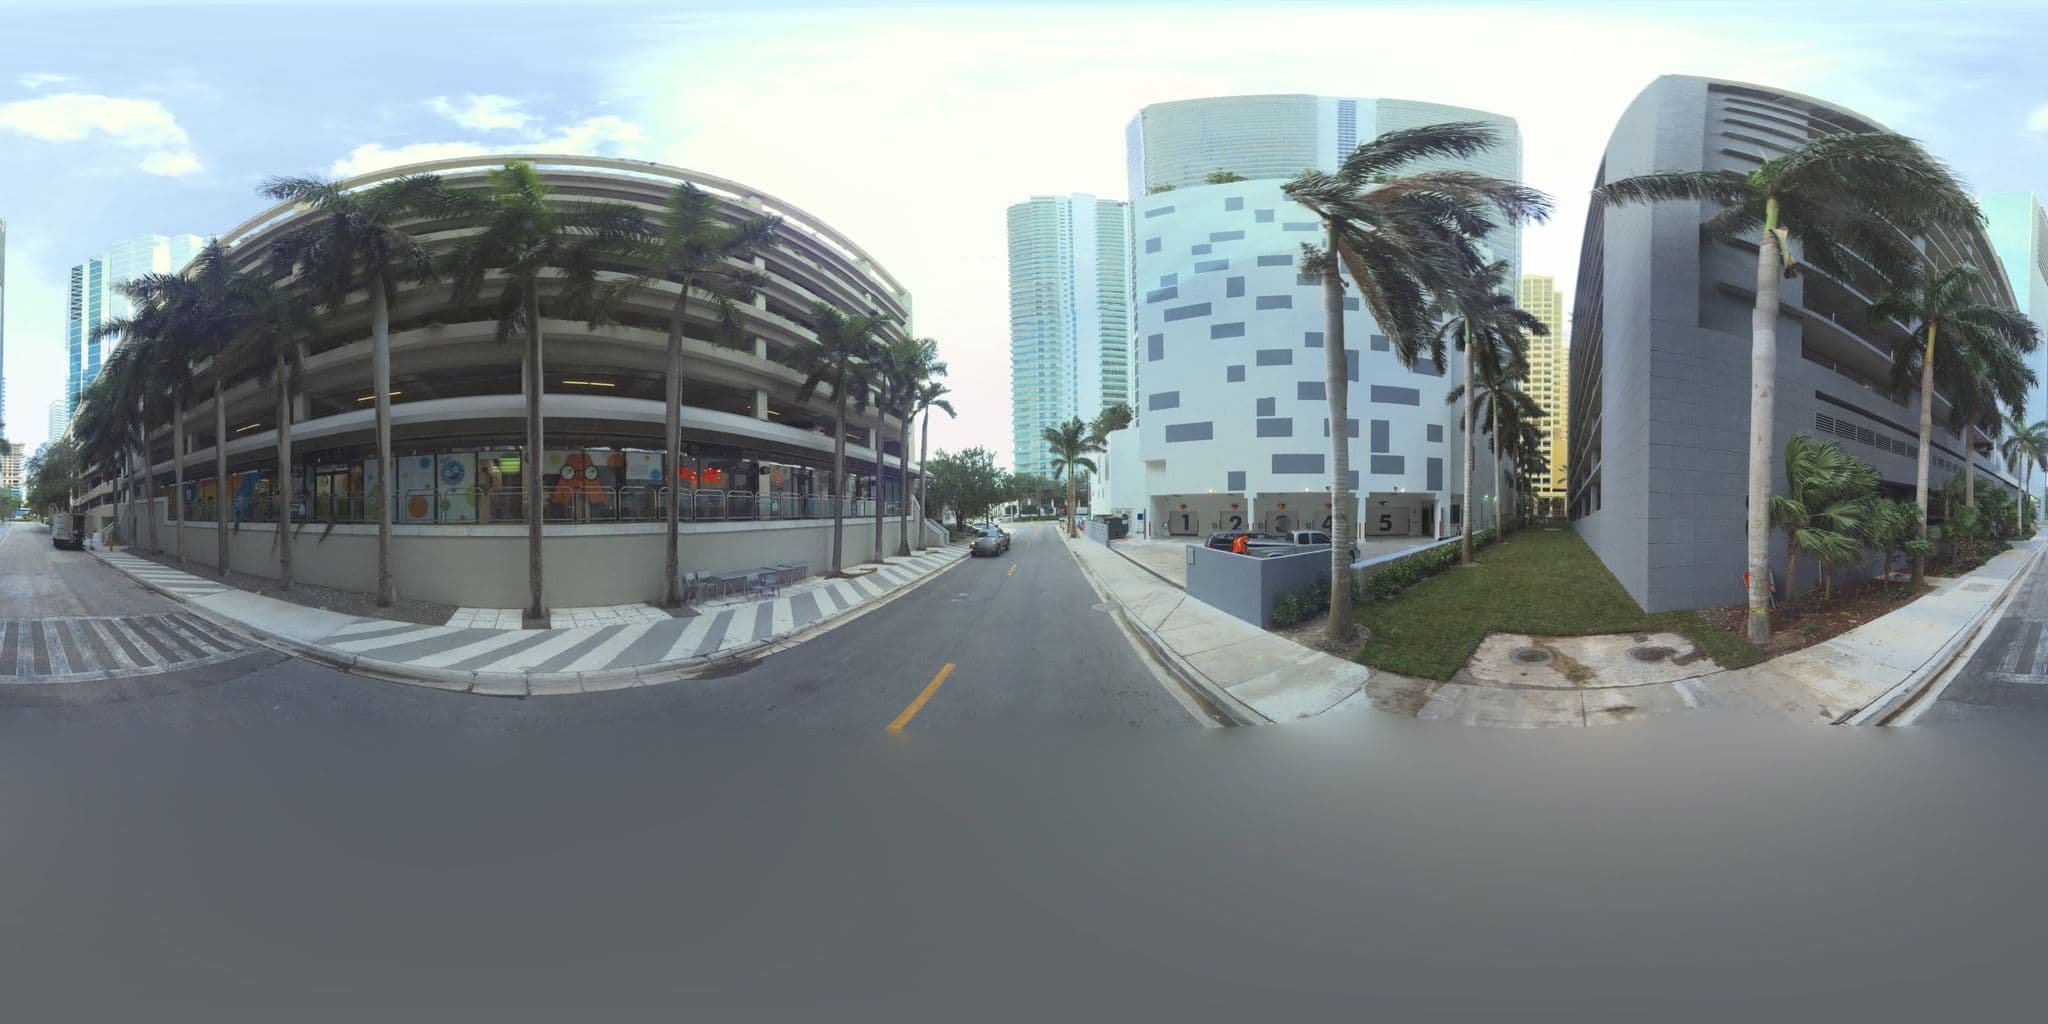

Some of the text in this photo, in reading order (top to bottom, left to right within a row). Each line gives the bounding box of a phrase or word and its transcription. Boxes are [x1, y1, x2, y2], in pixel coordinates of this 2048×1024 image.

[1182, 514, 1191, 531] 1
[1229, 515, 1242, 531] 2
[1322, 515, 1333, 532] 4
[1379, 514, 1392, 531] 5
